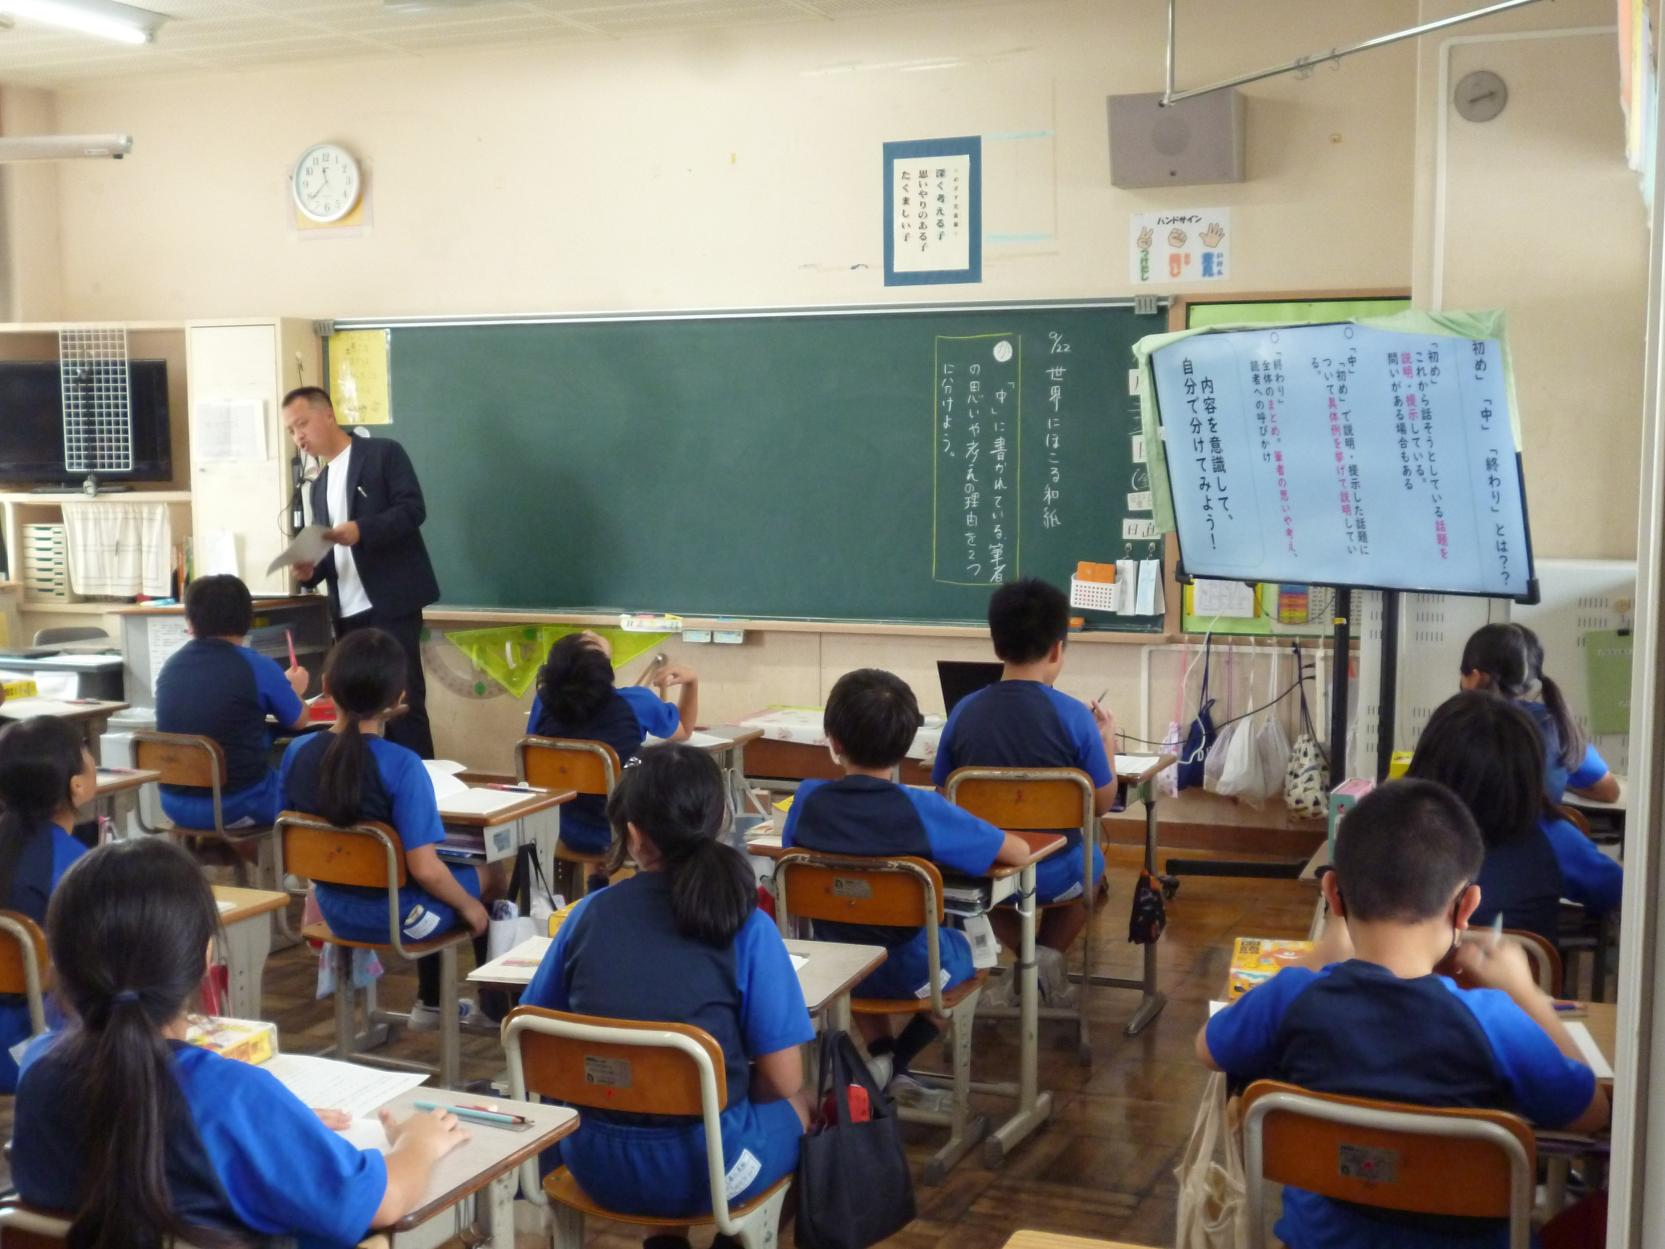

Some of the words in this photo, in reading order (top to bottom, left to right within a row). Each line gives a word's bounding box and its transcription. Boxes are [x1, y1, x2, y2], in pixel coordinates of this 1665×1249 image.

[917, 169, 929, 252] 思いやりのある子
[1156, 214, 1203, 226] ハンドサイン
[1048, 331, 1071, 353] 9/22
[1043, 367, 1066, 529] 世界にほこる和紙
[1182, 357, 1217, 550] 自分で分けてみよう！
[1200, 375, 1233, 520] 内容を意識して、
[1481, 398, 1493, 432] 「中」
